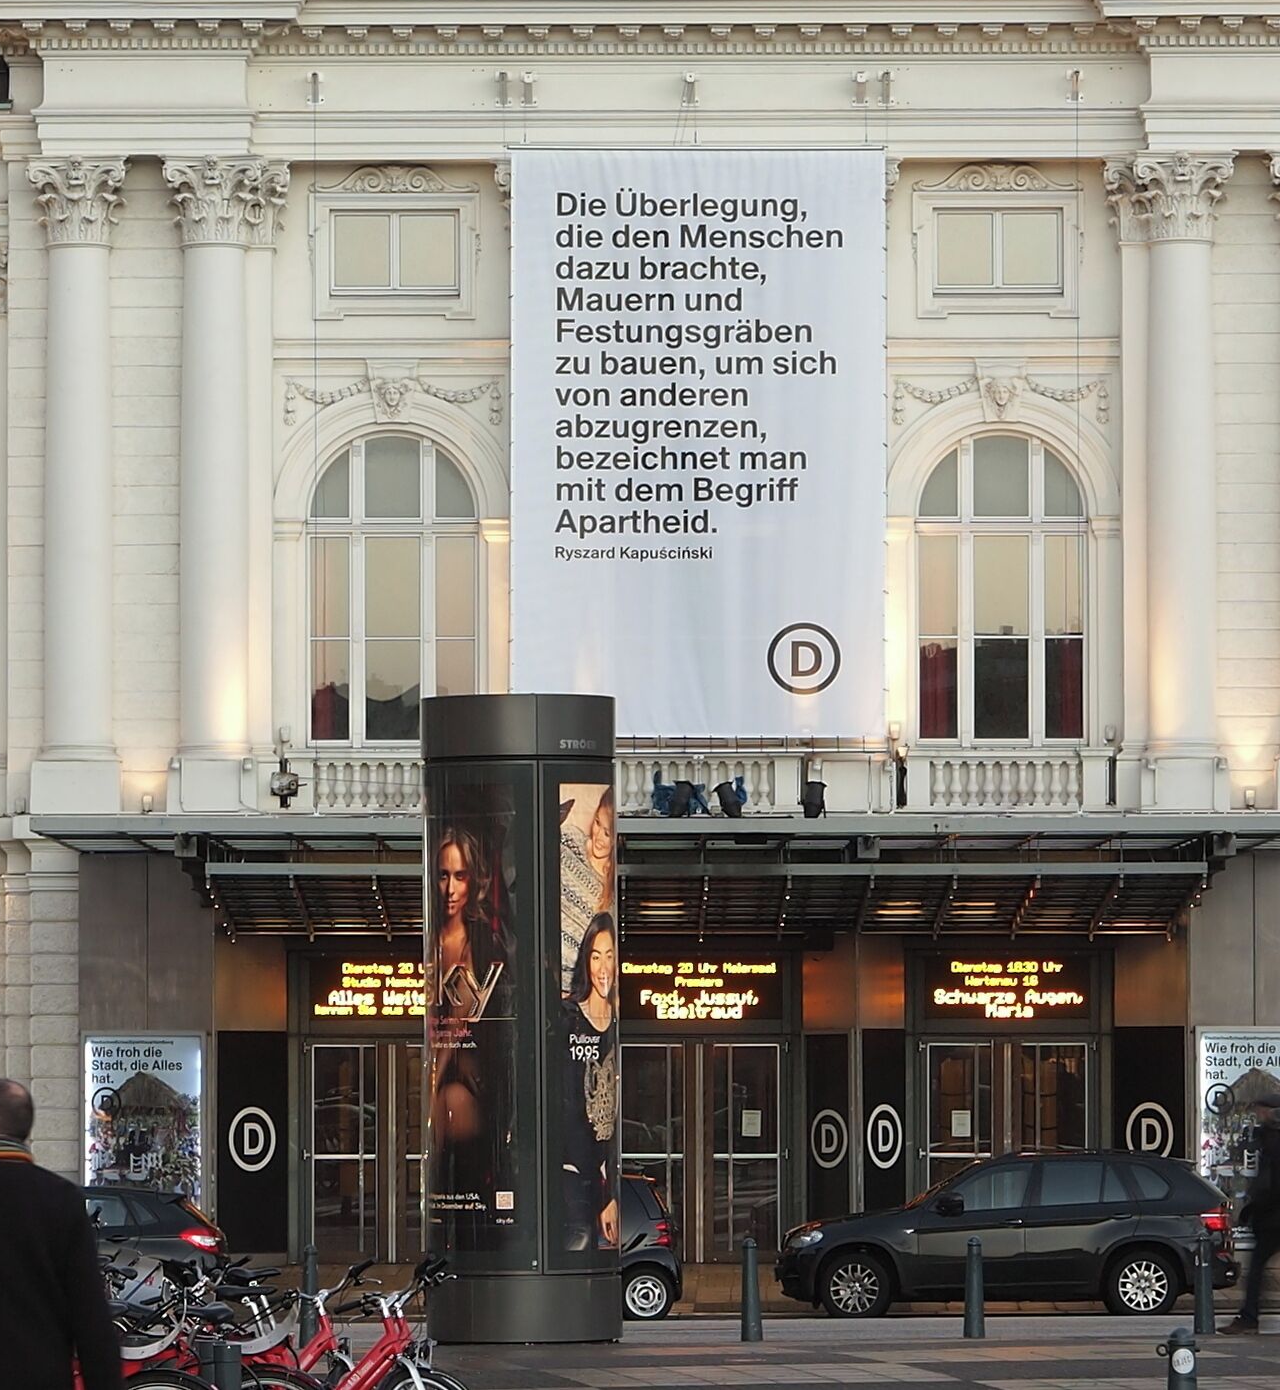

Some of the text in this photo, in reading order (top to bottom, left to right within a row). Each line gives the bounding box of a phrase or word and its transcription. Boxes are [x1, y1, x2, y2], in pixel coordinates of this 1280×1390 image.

[556, 188, 808, 222] Die Überlegung,
[555, 223, 843, 249] die den Menschen
[555, 255, 768, 285] dazu brachte,
[556, 287, 742, 312] Mauern und
[556, 318, 812, 349] Festungsgräben
[555, 350, 837, 380] zu bauen, um sich
[555, 382, 748, 407] von anderen
[555, 413, 767, 444] abzugrenzen,
[556, 445, 807, 471] bezeichnet man
[556, 477, 799, 508] mit dem Begriff
[554, 508, 718, 540] Apartheid.
[555, 545, 713, 563] Ryszard Kapuściński
[397, 962, 415, 974] 20
[621, 962, 673, 975] Dienstag
[677, 962, 694, 974] 20
[698, 962, 719, 974] Uhr
[950, 961, 1003, 974] Dienstag
[1042, 961, 1064, 973] Uhr
[341, 976, 382, 988] Studio
[674, 976, 724, 988] Premiere
[328, 990, 376, 1006] Alles
[933, 988, 1084, 1006] Schwarze Augen,
[656, 1002, 744, 1020] Edeltraud
[985, 1001, 1034, 1018] Maria
[569, 1034, 601, 1044] Pullover
[91, 1046, 162, 1058] Wie froh die
[569, 1045, 600, 1062] 19,95
[1205, 1042, 1277, 1054] Wie froh die
[91, 1059, 183, 1072] Stadt, die Alles
[1205, 1056, 1241, 1069] Stadt,
[1244, 1056, 1263, 1067] die
[91, 1073, 114, 1084] hat.
[1205, 1069, 1228, 1080] hat.
